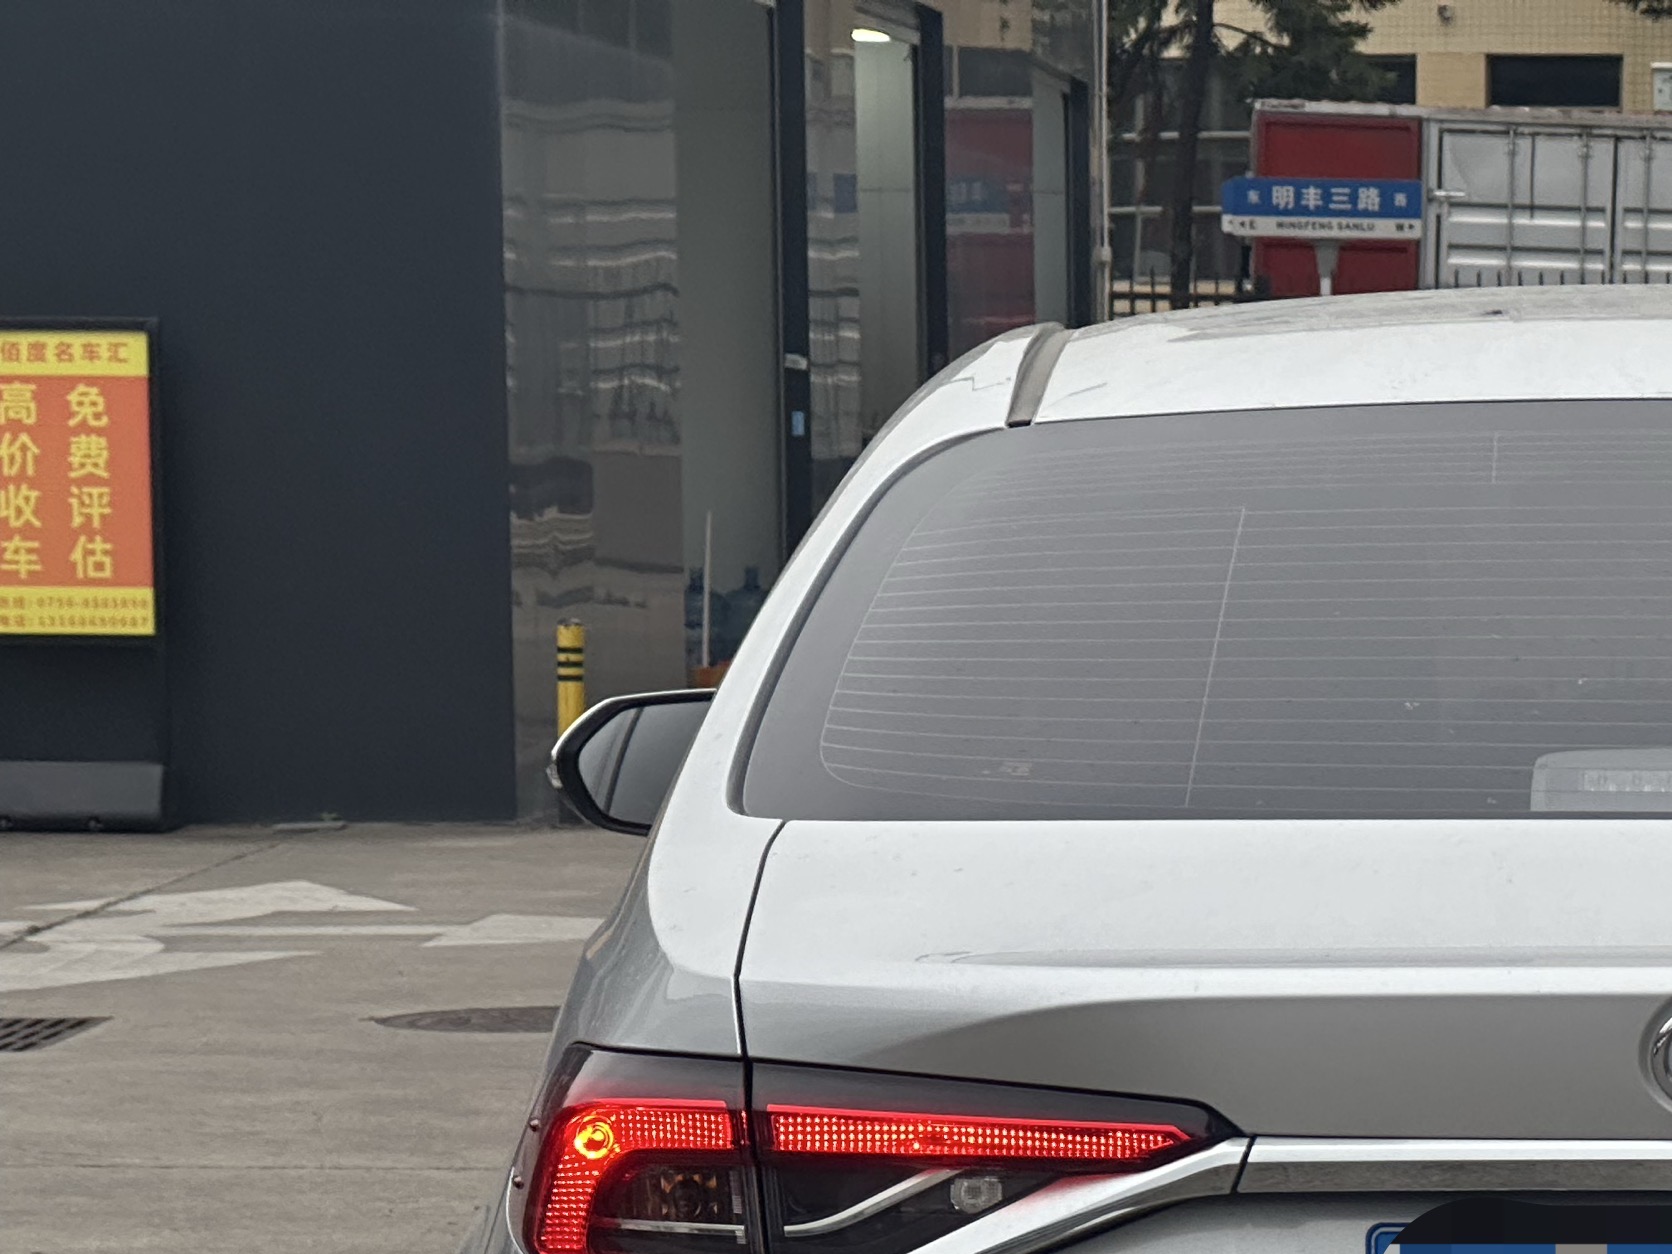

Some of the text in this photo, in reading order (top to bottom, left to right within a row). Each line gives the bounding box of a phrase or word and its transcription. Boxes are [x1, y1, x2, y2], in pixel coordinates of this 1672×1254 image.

[1271, 185, 1381, 212] 明丰三路
[1276, 220, 1334, 231] MINGFENG
[1337, 221, 1375, 232] SANLU
[0, 382, 42, 579] 高价收车
[66, 383, 114, 580] 免费评估
